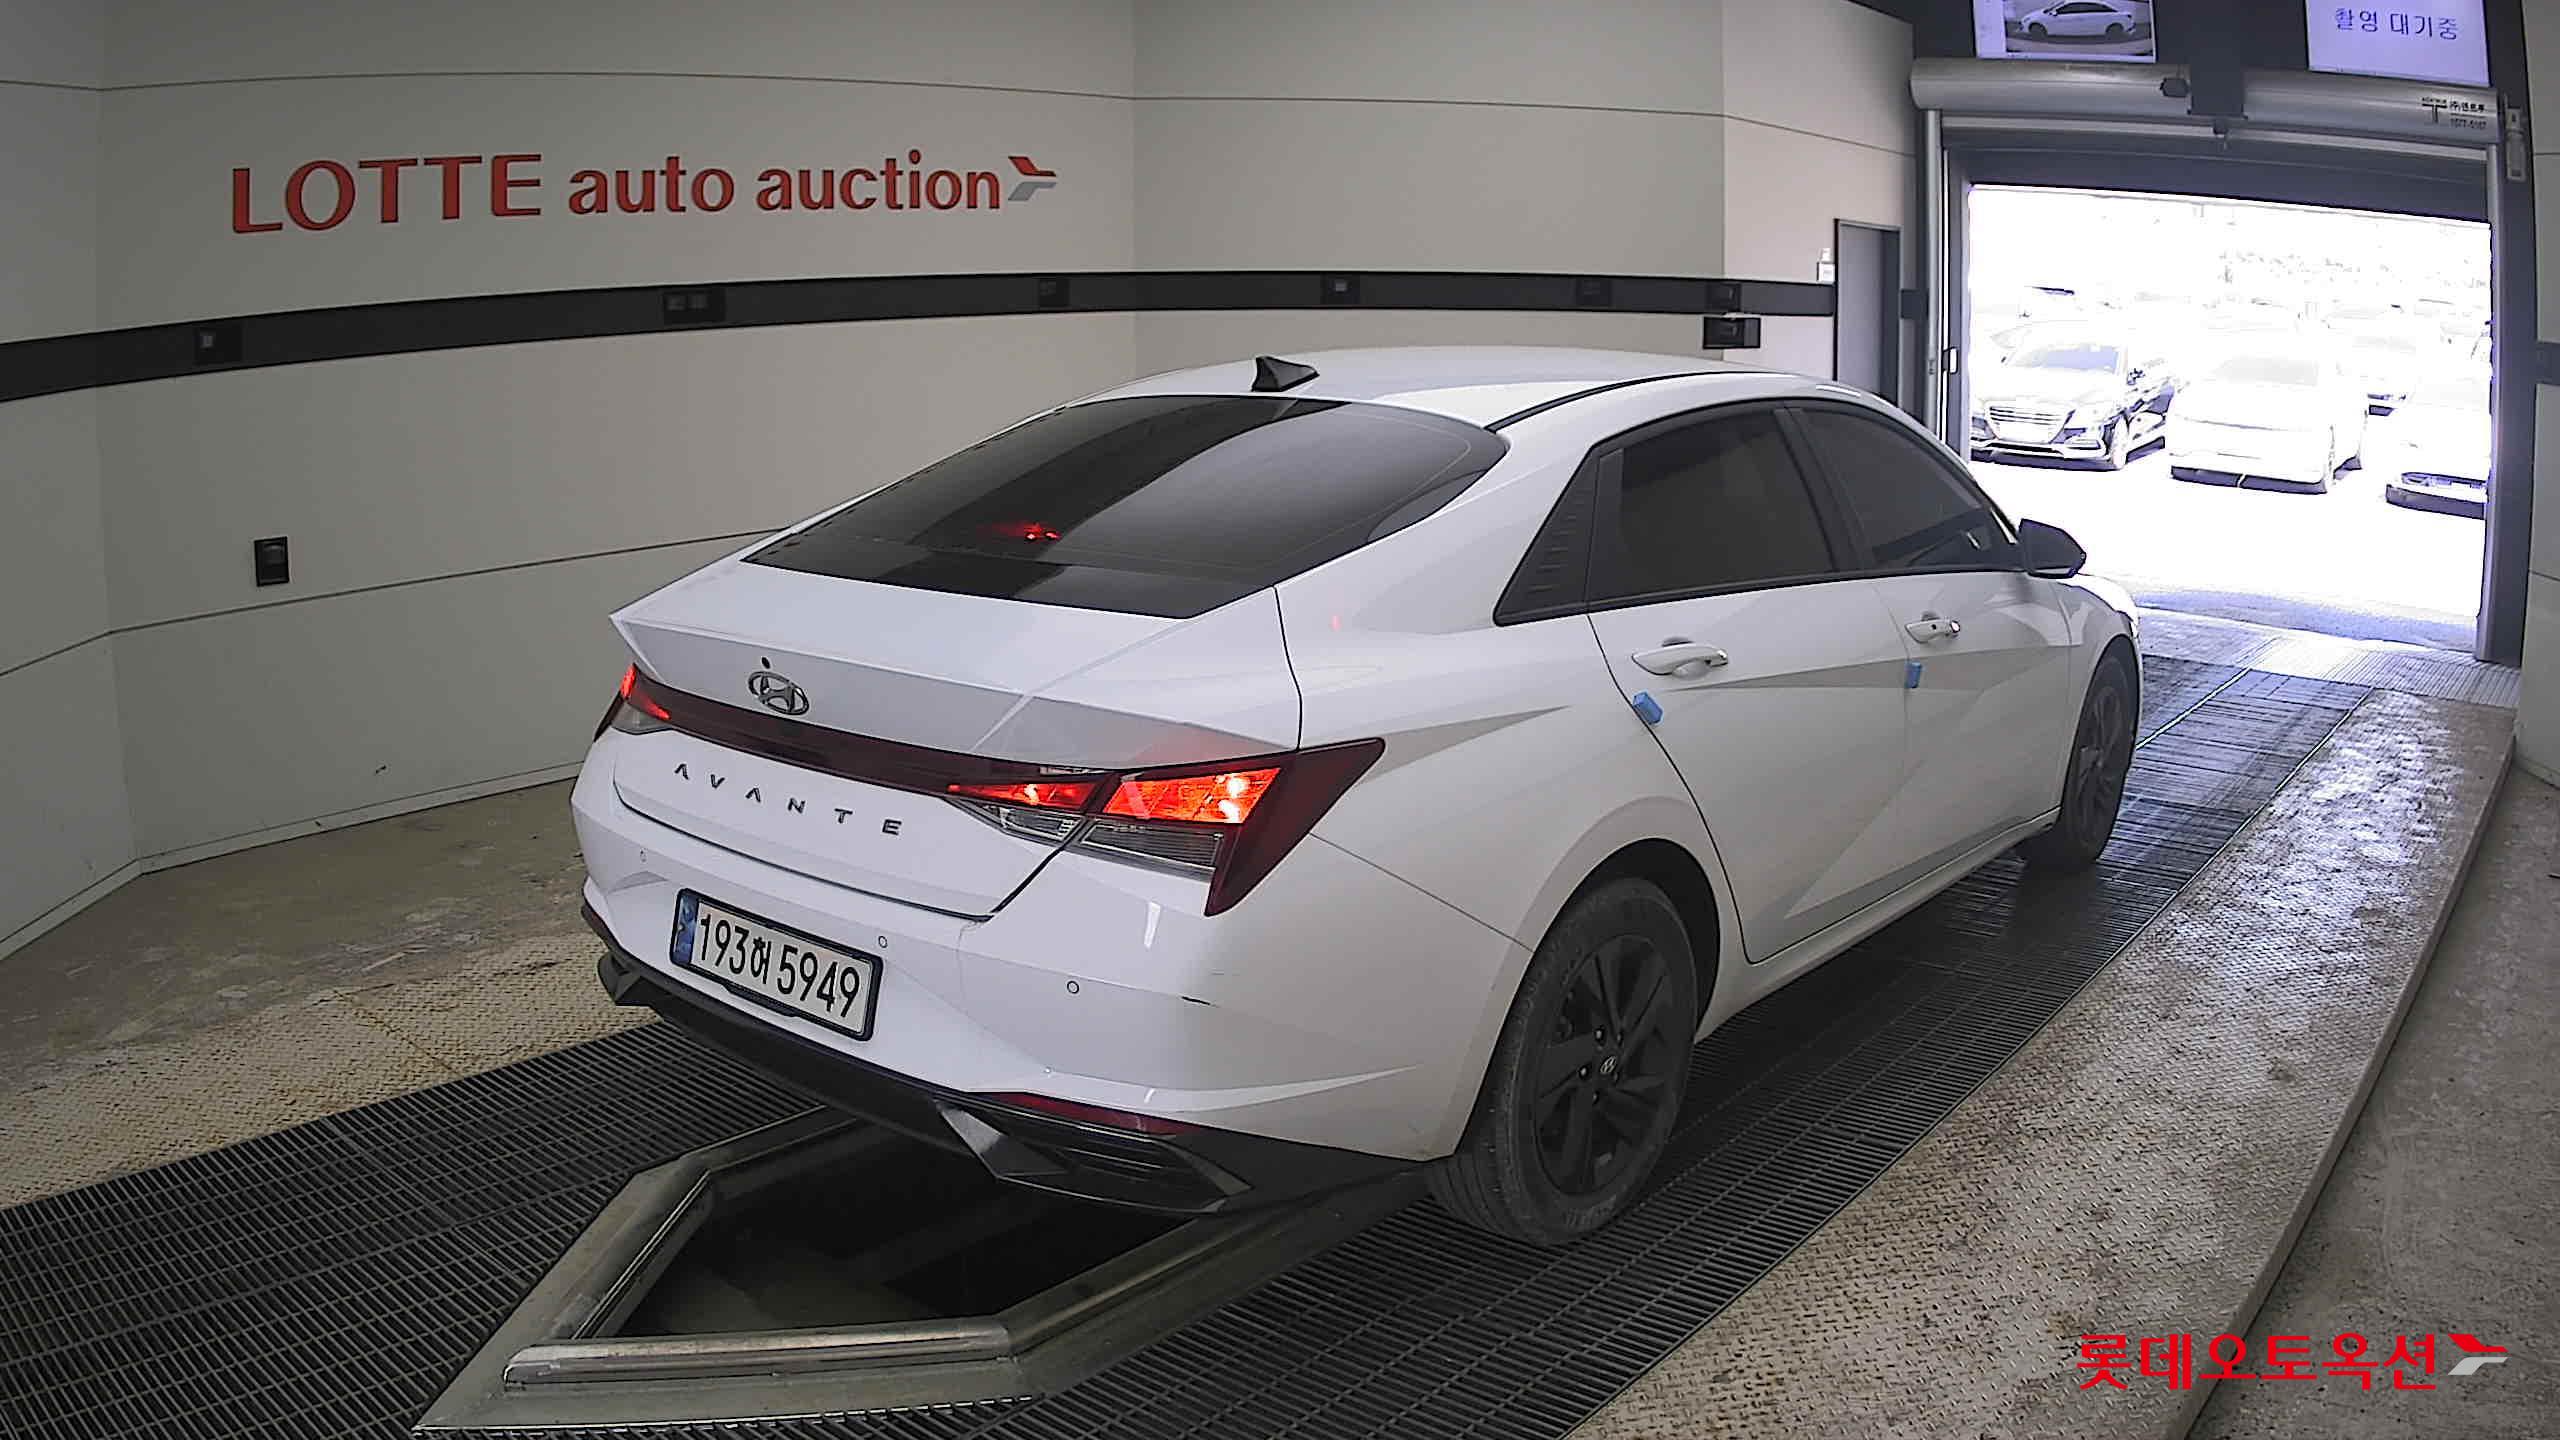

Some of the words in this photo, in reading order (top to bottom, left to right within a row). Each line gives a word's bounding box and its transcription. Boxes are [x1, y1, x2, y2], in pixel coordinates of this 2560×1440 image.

[2335, 8, 2379, 33] 촬영
[2390, 13, 2458, 41] 대기중
[232, 154, 542, 234] LOTTE
[568, 155, 735, 215] auto
[755, 149, 1001, 211] auction
[674, 763, 902, 836] AVANTE
